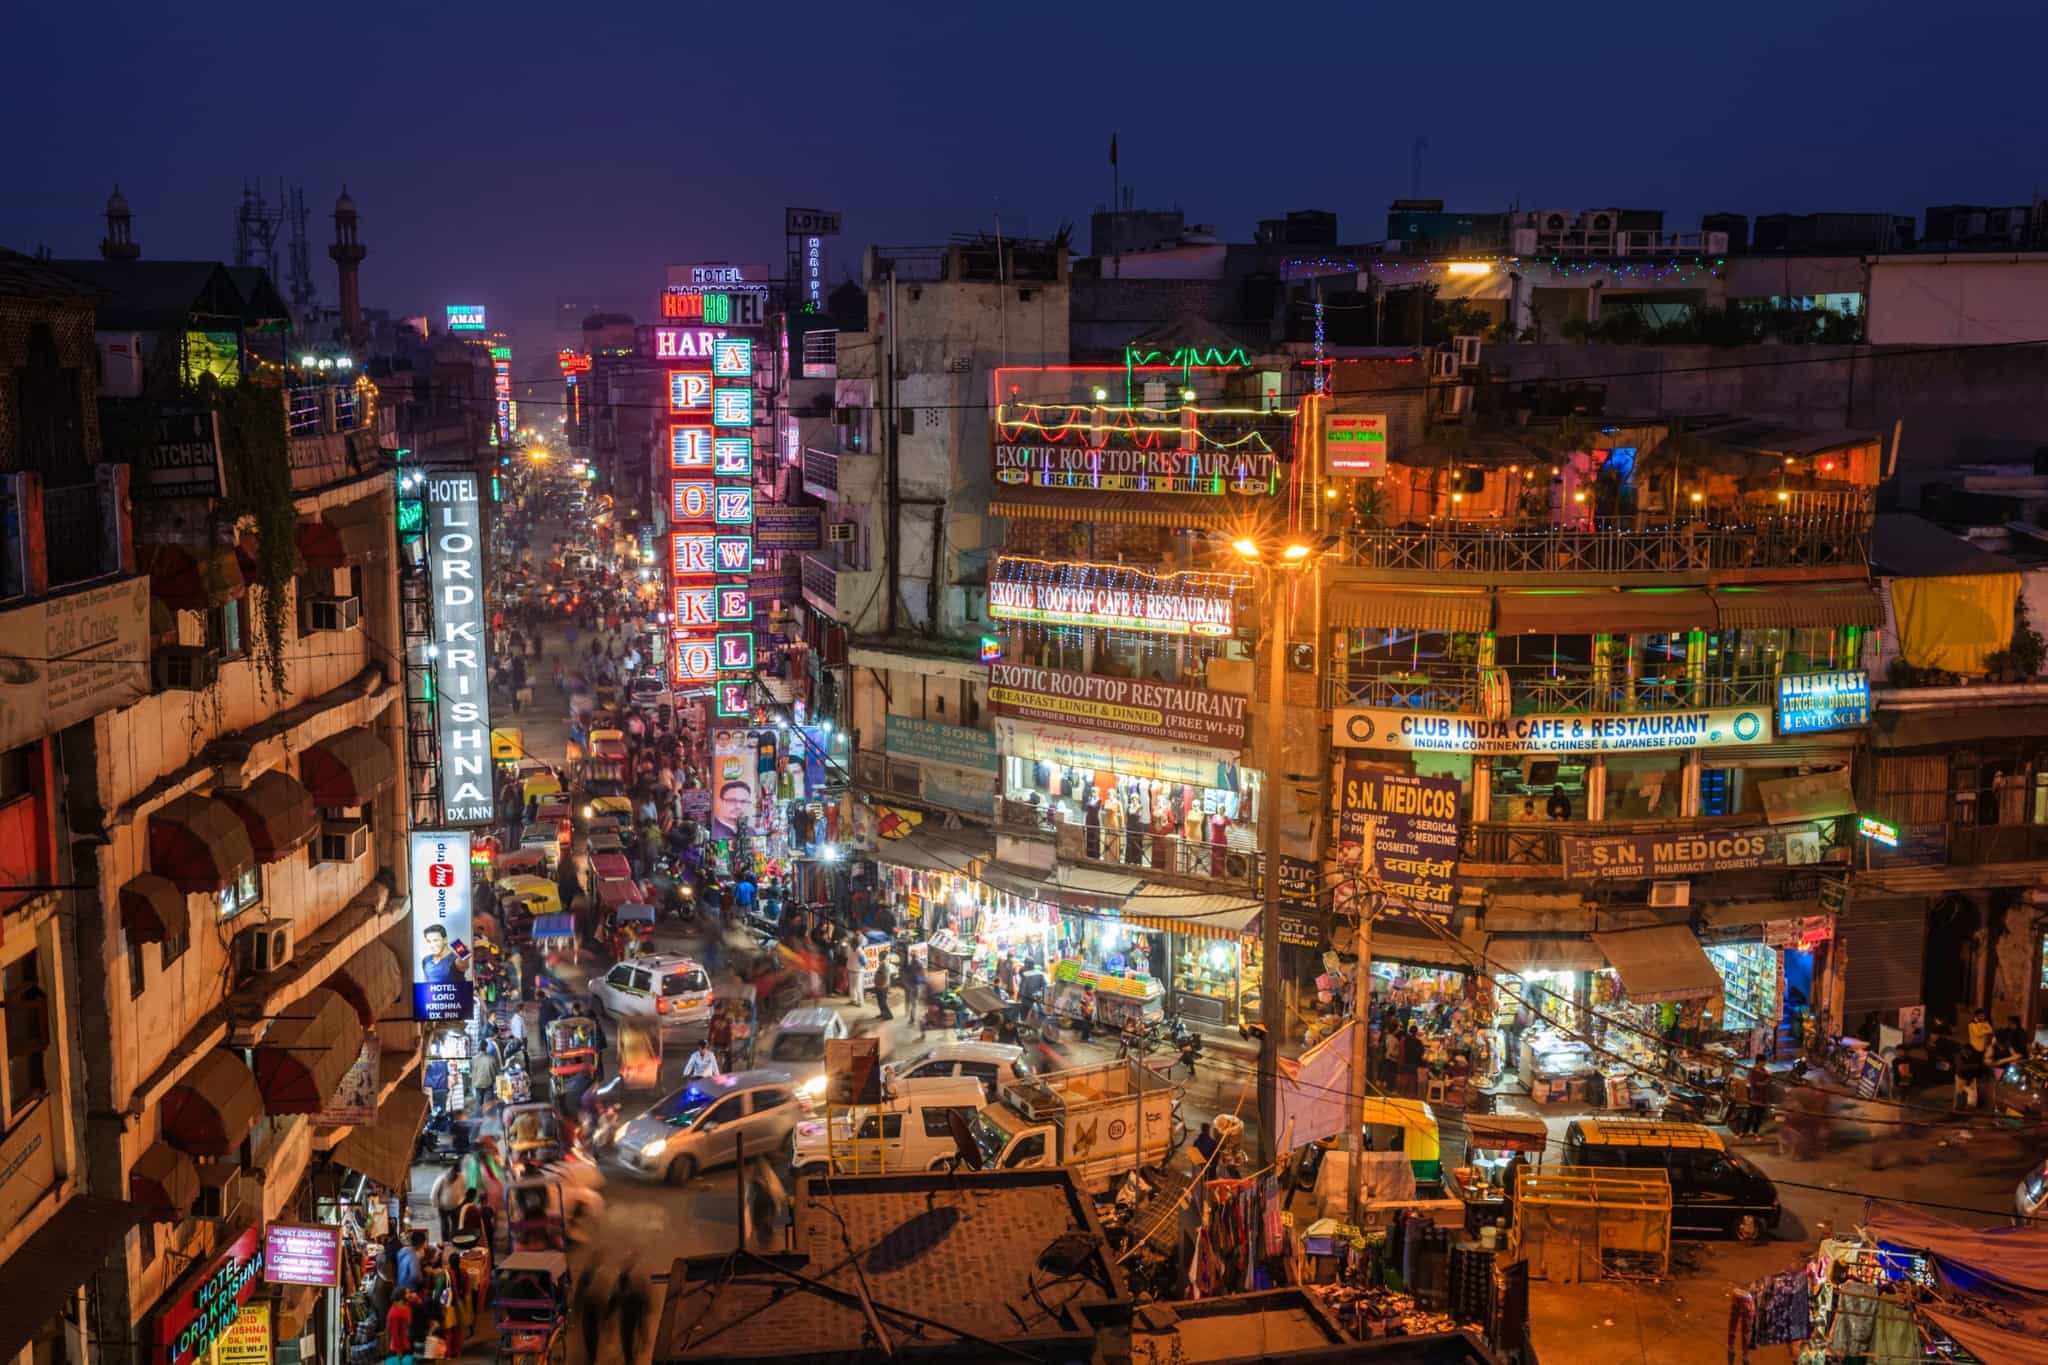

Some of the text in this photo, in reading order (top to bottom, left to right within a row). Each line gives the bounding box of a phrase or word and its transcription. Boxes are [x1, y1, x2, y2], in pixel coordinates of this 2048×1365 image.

[693, 268, 742, 283] HOTEL
[704, 294, 764, 323] HOTEL
[658, 332, 726, 356] HAR
[146, 440, 214, 466] ITCHEN
[996, 445, 1270, 477] EXOTIC ROOFTOP RESTAURANT
[430, 479, 478, 502] HOTEL
[1041, 471, 1104, 489] BREAKFAST
[1119, 474, 1156, 491] LUNCH
[1172, 478, 1217, 494] DINNER
[990, 581, 1033, 608] EXOTIC
[1037, 584, 1095, 614] ROOFTOP
[1098, 590, 1130, 616] CAFE
[1133, 594, 1142, 616] &
[1147, 594, 1232, 624] RESTAURANT
[440, 507, 486, 802] LORD KRISHNA
[991, 663, 1247, 720] EXOTIC ROOFTOP RESTAURANT
[1782, 672, 1865, 695] BREAKFAST
[992, 688, 1160, 723] BREAKFAST LUNCH & DINNER
[1783, 695, 1815, 712] LUNCH
[1829, 693, 1866, 710] DINNER
[1019, 708, 1209, 743] REMEMBER US FOR DELICIOUS FOOD SERVICES
[1165, 715, 1246, 739] (FREE WI-FI)
[1401, 714, 1710, 739] CLUB INDIA CAFE & RESTAURANT
[1795, 712, 1857, 728] ENTRANCE
[1414, 735, 1697, 751] INDIAN CONTINENTAL CHINESE & JAPANESE FOOD
[1347, 780, 1456, 819] S.N. MEDICOS
[1415, 819, 1458, 833] SERGICAL
[1376, 841, 1419, 855] COSMETIC
[1415, 832, 1457, 846] MEDICINE
[1593, 836, 1765, 865] S.N. MEDICOS
[1258, 861, 1316, 880] EOTIC
[1601, 858, 1759, 877] CHEMIST PHARMACY COSMETIC
[432, 993, 455, 1001] LORD
[200, 1256, 240, 1308] HOTEL
[172, 1252, 263, 1364] LORD KRISHNA
[219, 1299, 239, 1332] INN
[246, 1345, 269, 1353] WI-FI
